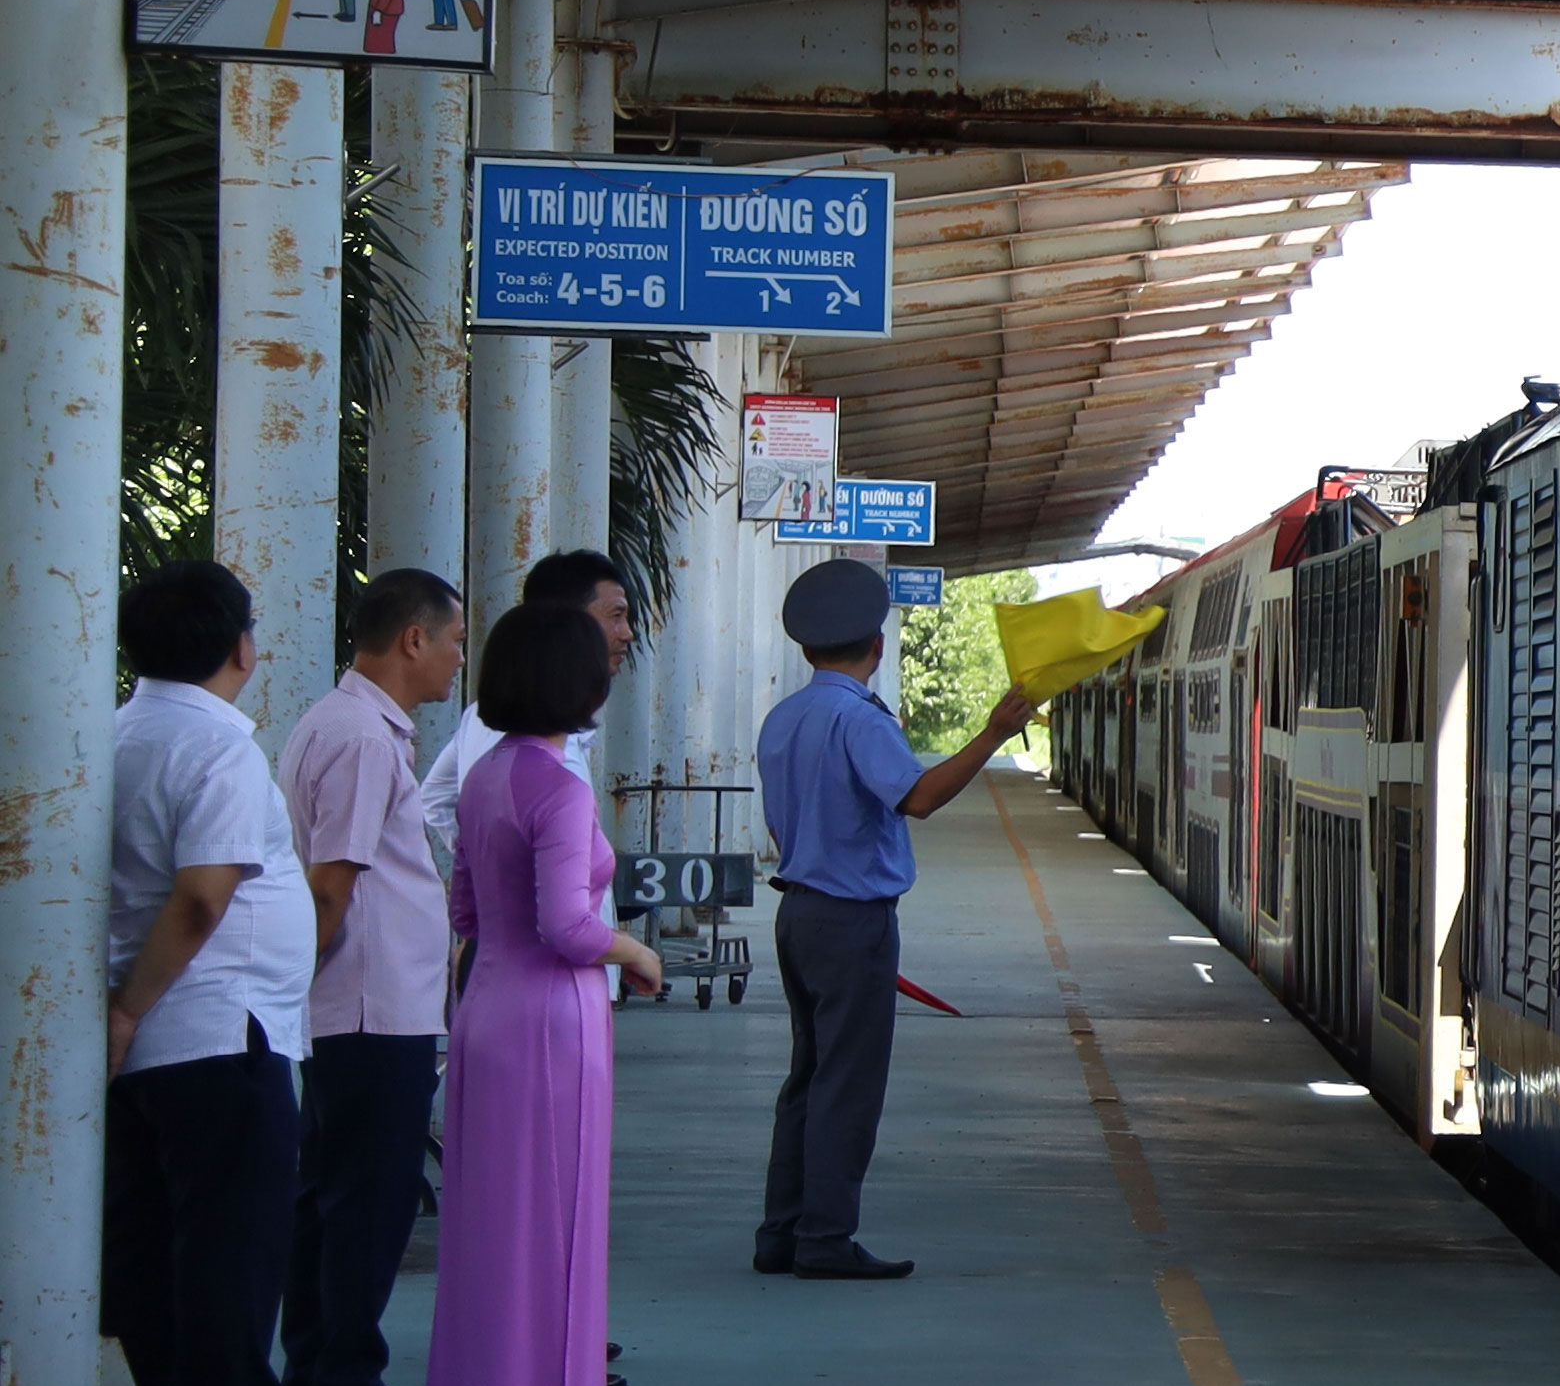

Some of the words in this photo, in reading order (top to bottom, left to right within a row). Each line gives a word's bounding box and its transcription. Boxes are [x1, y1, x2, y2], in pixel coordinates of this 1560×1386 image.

[498, 188, 520, 232] VỊ
[528, 182, 566, 225] TRÍ
[573, 188, 607, 234] DỰ
[612, 182, 668, 229] KIẾN
[700, 188, 813, 234] ĐƯỜNG
[823, 189, 869, 237] SỐ
[495, 239, 580, 258] EXPECTED
[585, 242, 668, 261] POSITION
[711, 246, 772, 264] TRACK
[777, 249, 856, 268] NUMBER
[496, 272, 525, 285] Toa
[529, 272, 552, 286] số:
[496, 290, 548, 304] Coach:
[557, 272, 666, 308] 4-5-6
[759, 290, 769, 312] 1
[825, 292, 842, 314] 2
